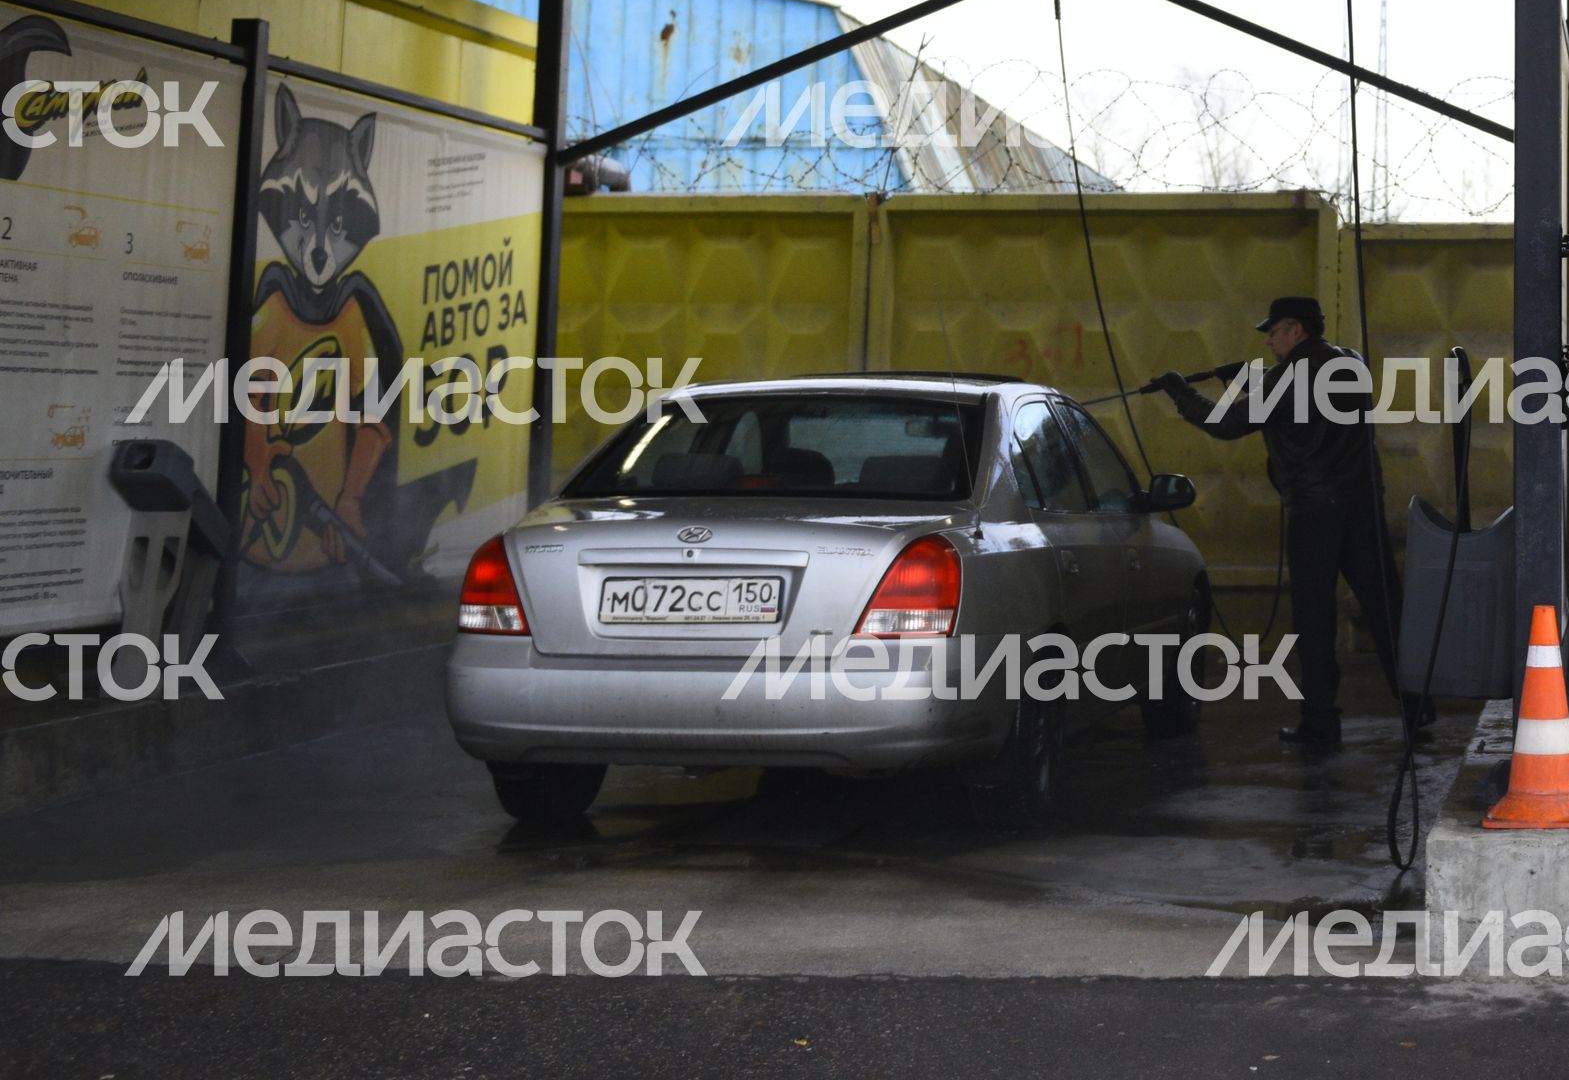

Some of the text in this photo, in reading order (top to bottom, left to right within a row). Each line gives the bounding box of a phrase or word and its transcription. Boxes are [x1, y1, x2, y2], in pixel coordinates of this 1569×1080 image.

[1, 216, 13, 240] 2
[124, 232, 134, 255] 3
[422, 237, 514, 305] ПОМОЙ
[419, 290, 528, 352] АВТО ЗА
[732, 582, 773, 604] 150
[738, 605, 760, 613] RUS
